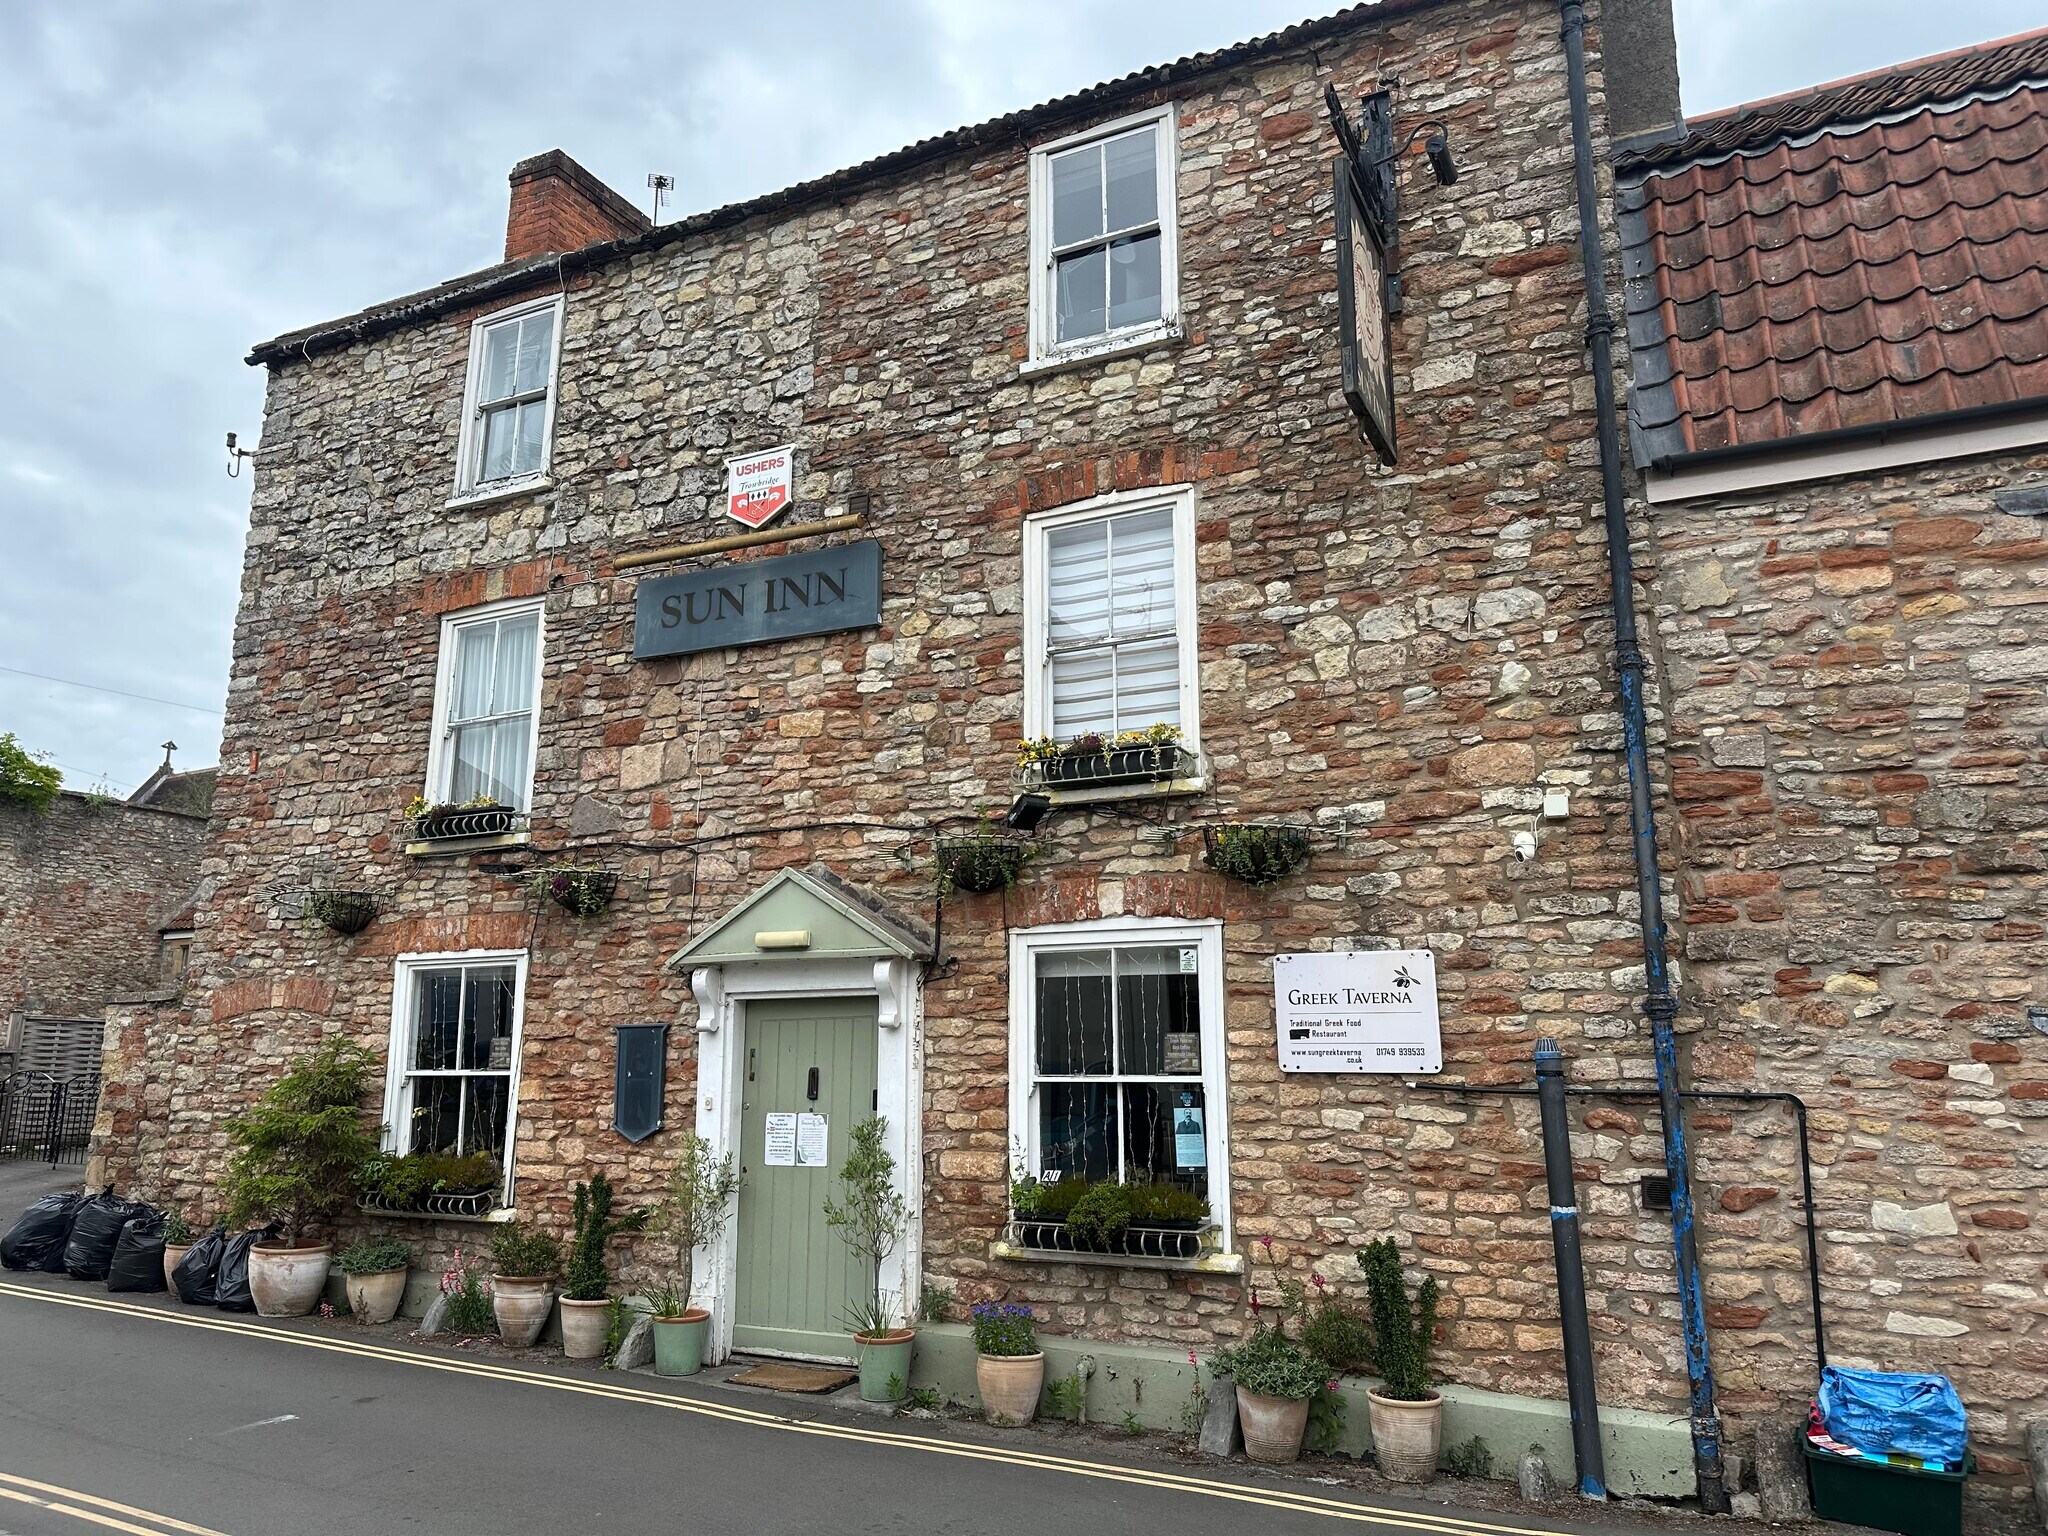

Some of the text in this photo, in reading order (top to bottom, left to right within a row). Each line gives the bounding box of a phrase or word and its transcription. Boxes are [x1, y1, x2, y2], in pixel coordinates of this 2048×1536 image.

[736, 457, 785, 477] USHERS
[739, 477, 779, 492] Trowbridge
[661, 567, 849, 629] SUN INN
[1288, 988, 1412, 1006] GREEK TAVERNA
[1289, 1018, 1362, 1027] Traditional Greek Food
[1311, 1029, 1347, 1038] Restaurant
[1291, 1047, 1426, 1057] www.sungreektaverna 01749 939533
[1346, 1056, 1363, 1064] .co.uk
